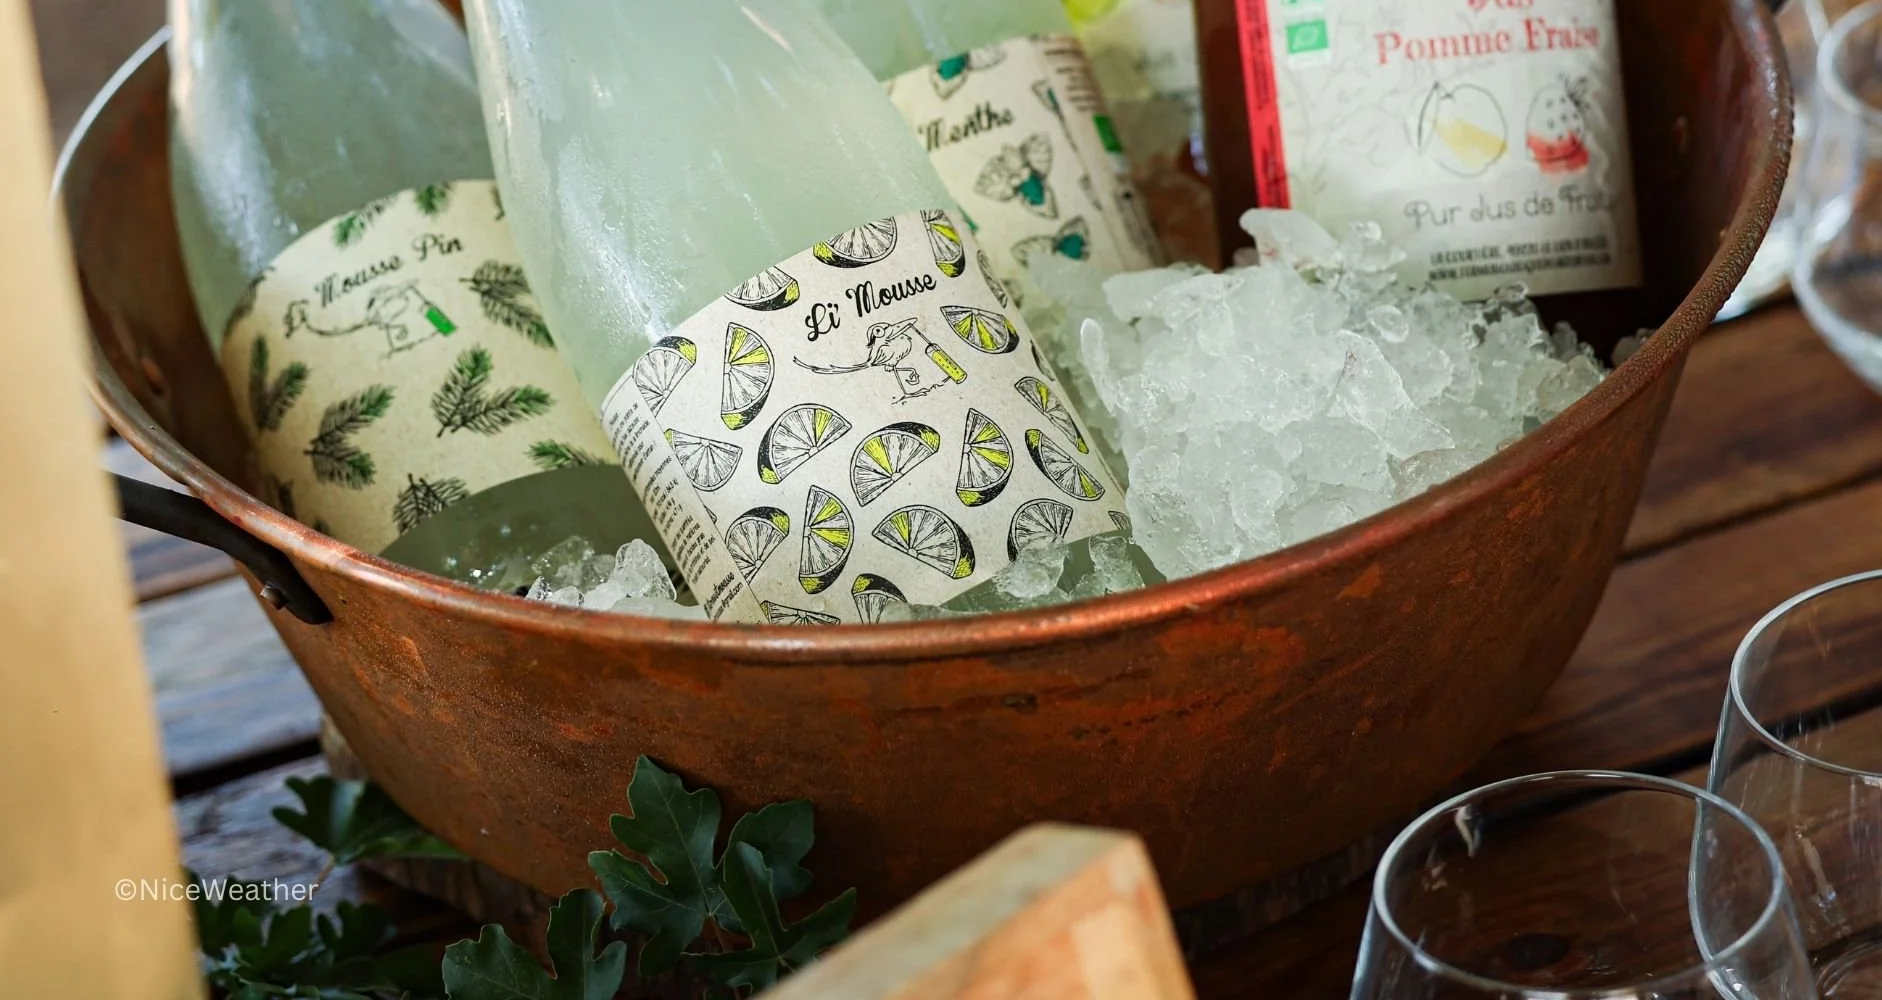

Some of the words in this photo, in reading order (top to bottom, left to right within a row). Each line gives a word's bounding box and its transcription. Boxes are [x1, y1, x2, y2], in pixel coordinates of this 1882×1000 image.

[1375, 31, 1511, 65] Pomme
[1524, 16, 1599, 52] Fraise
[917, 101, 1014, 152] Menthe
[1404, 199, 1461, 229] Pur
[1523, 189, 1554, 217] de
[315, 256, 404, 307] Mousse
[413, 233, 463, 261] Pin
[846, 274, 937, 318] Mousse
